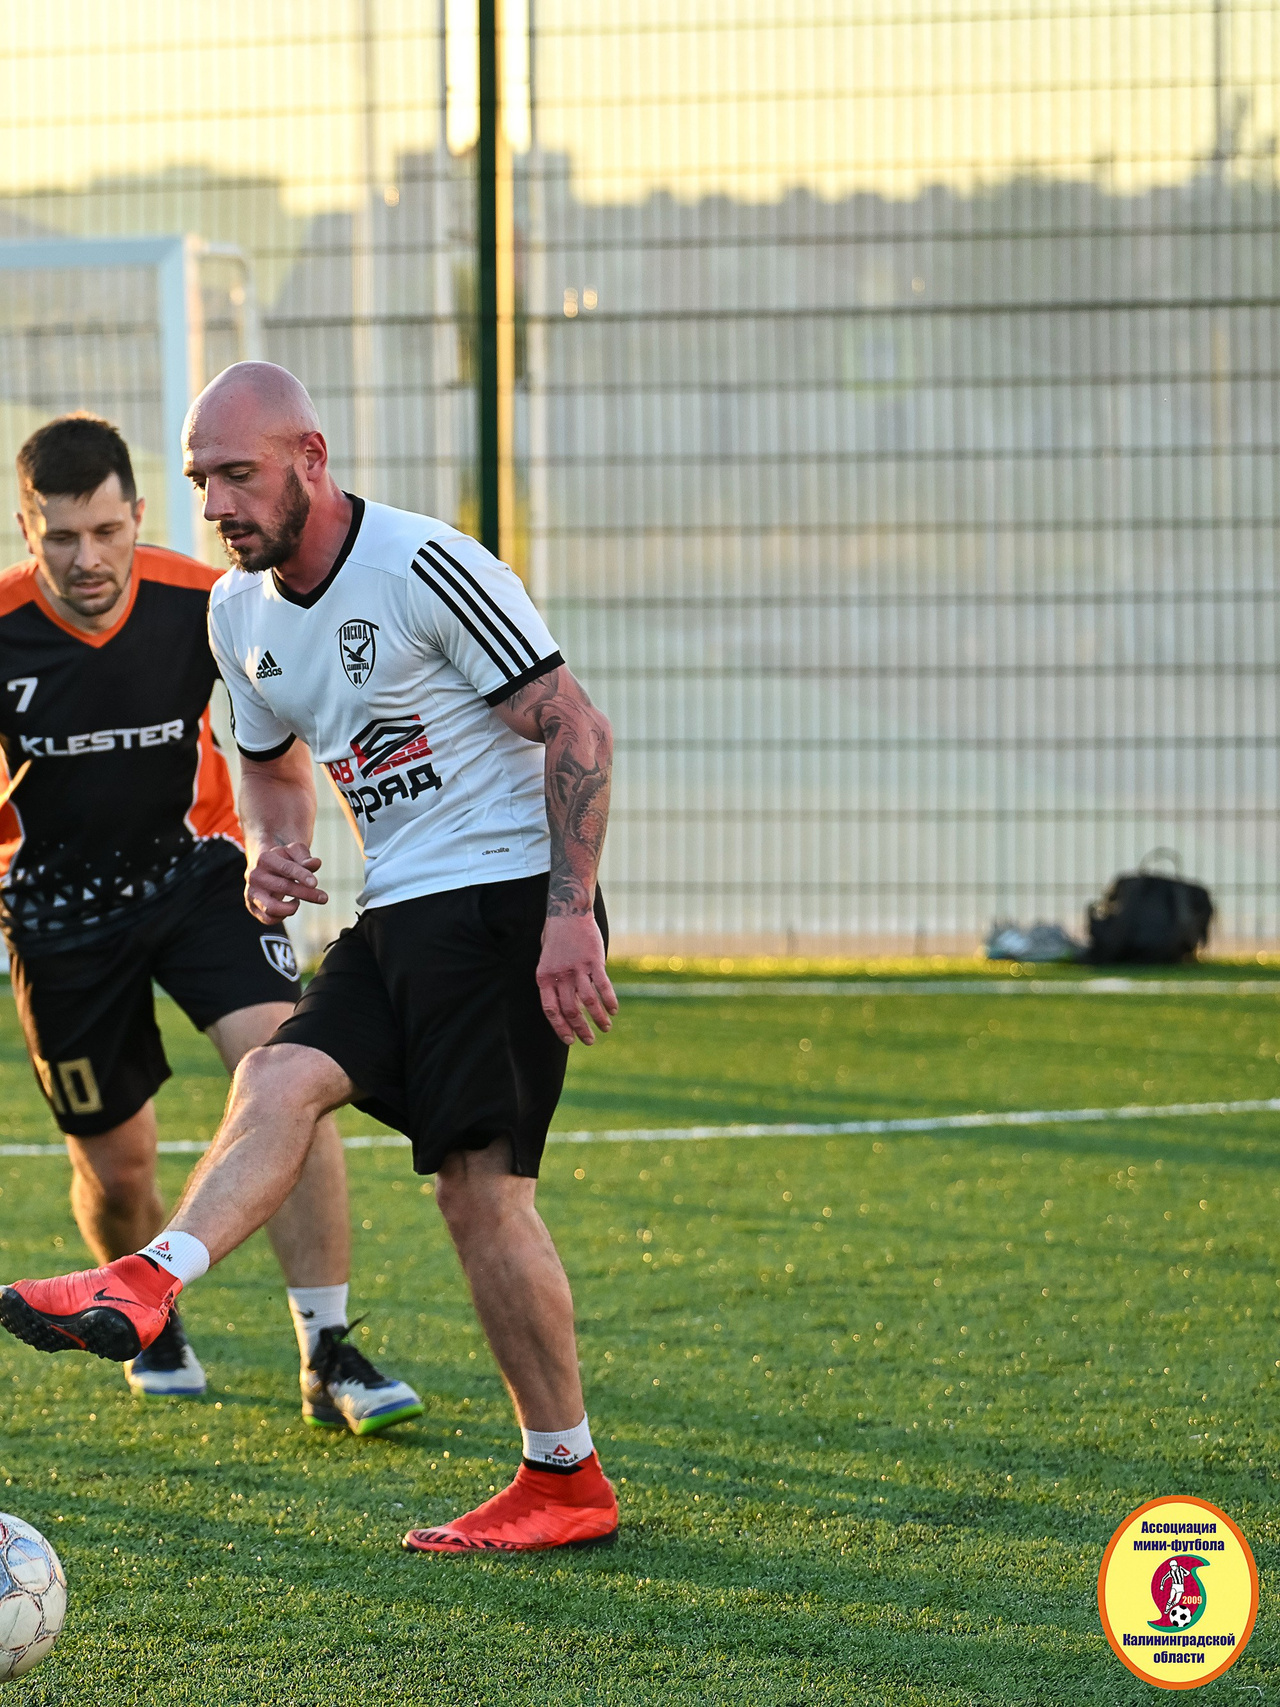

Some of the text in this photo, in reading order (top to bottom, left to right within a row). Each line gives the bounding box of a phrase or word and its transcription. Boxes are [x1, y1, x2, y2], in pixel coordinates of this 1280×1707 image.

[256, 667, 283, 679] adidas
[6, 676, 38, 713] 7
[19, 718, 185, 757] KLESTER
